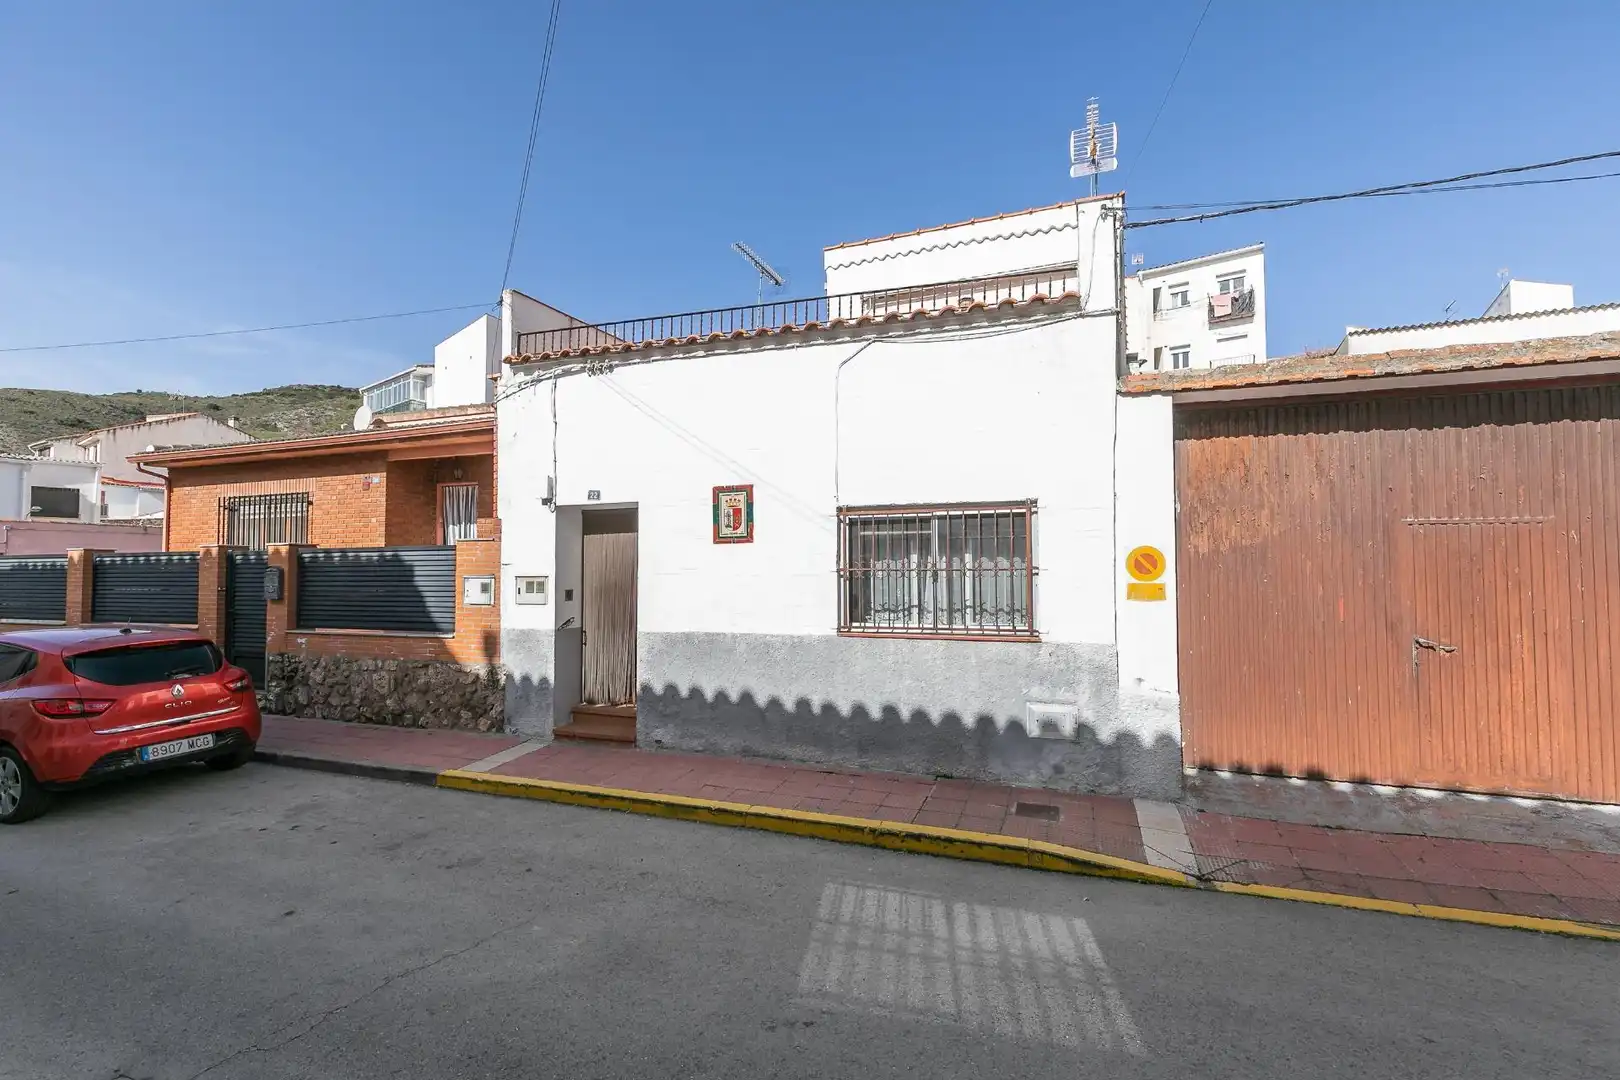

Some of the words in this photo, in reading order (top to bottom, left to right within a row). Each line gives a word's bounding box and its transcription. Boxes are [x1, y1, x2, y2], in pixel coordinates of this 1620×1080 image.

[164, 700, 192, 709] CLIO
[151, 741, 183, 757] 8907
[187, 736, 210, 749] MCG
